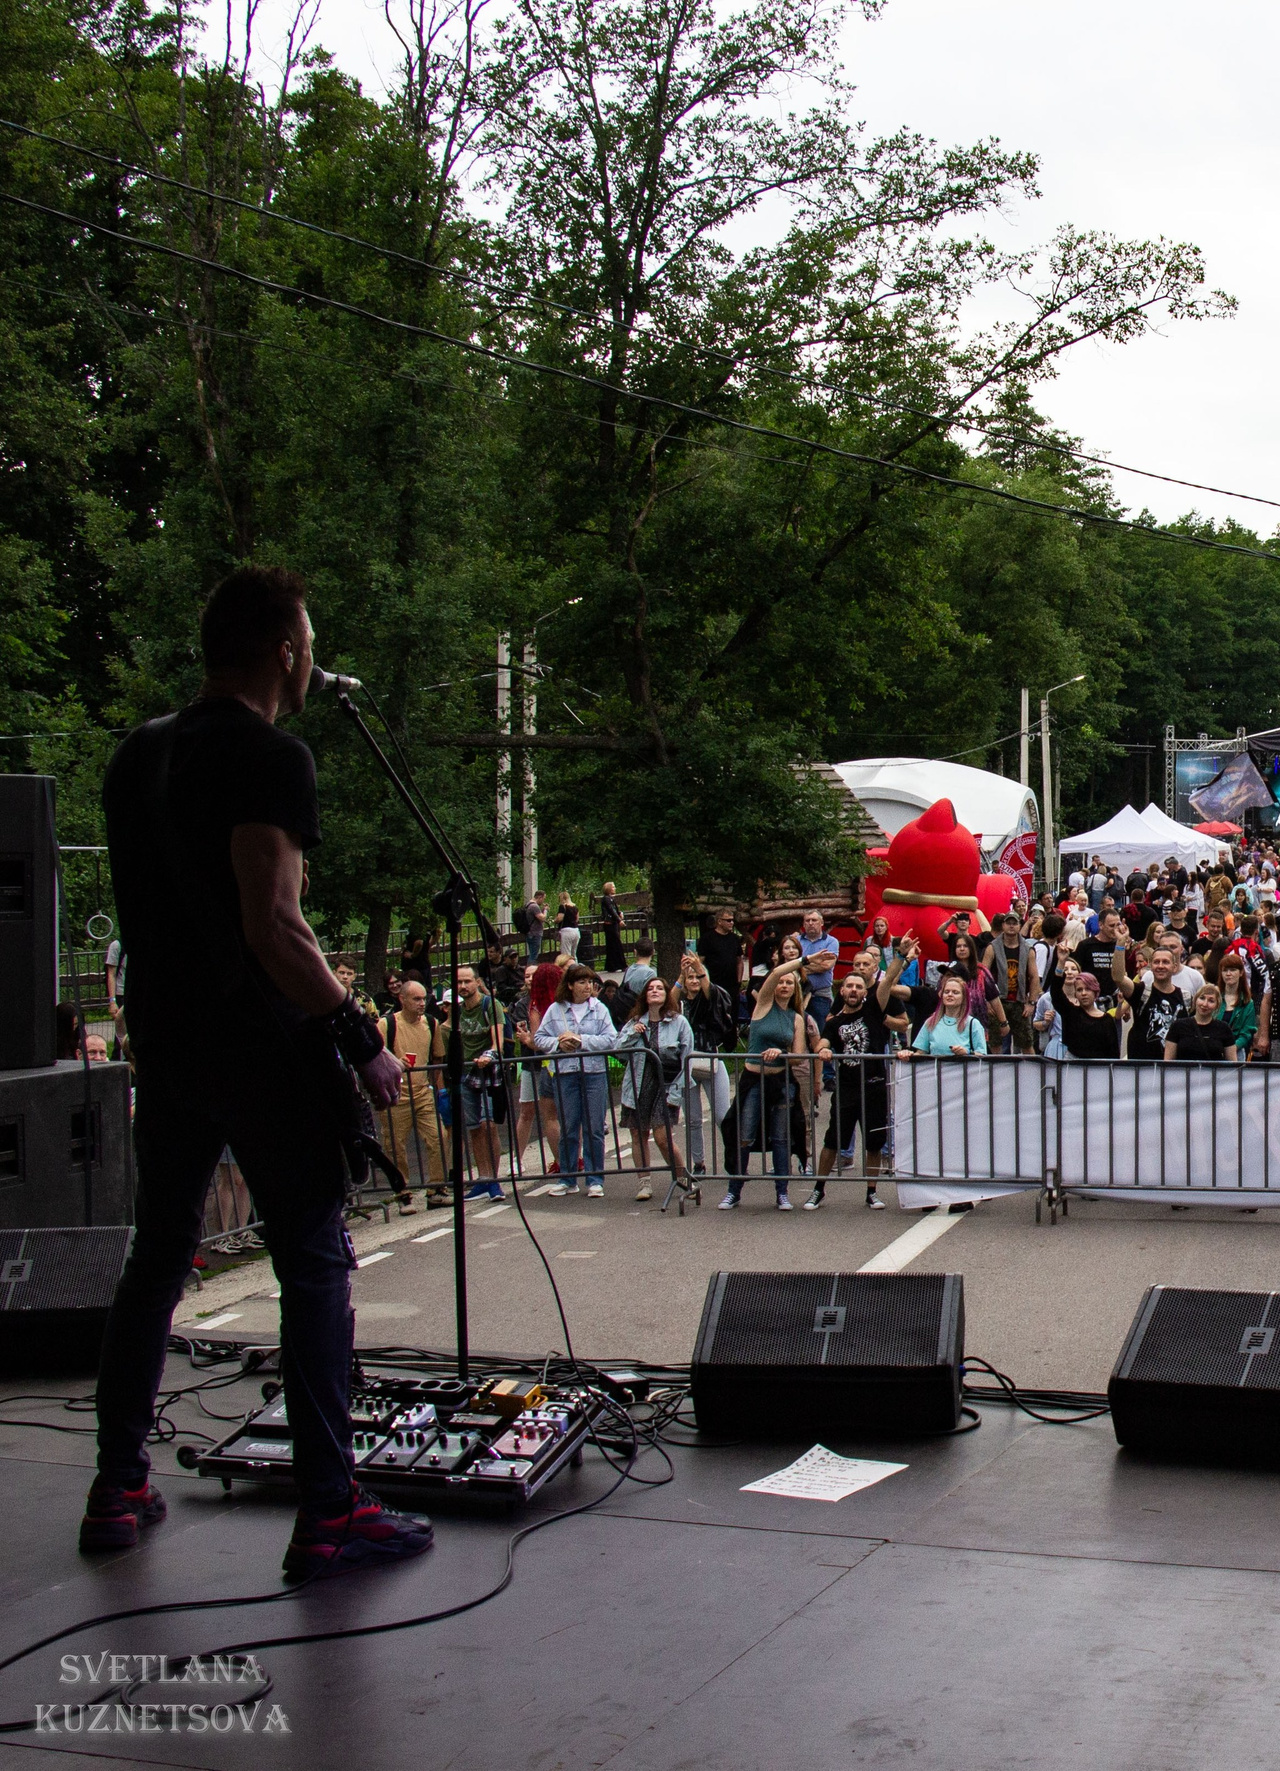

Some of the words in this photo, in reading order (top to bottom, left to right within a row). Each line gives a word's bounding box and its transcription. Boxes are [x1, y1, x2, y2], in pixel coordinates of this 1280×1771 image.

[1000, 863, 1015, 876] ДЛЯ
[821, 1310, 838, 1329] JBL
[1246, 1331, 1267, 1350] JBL
